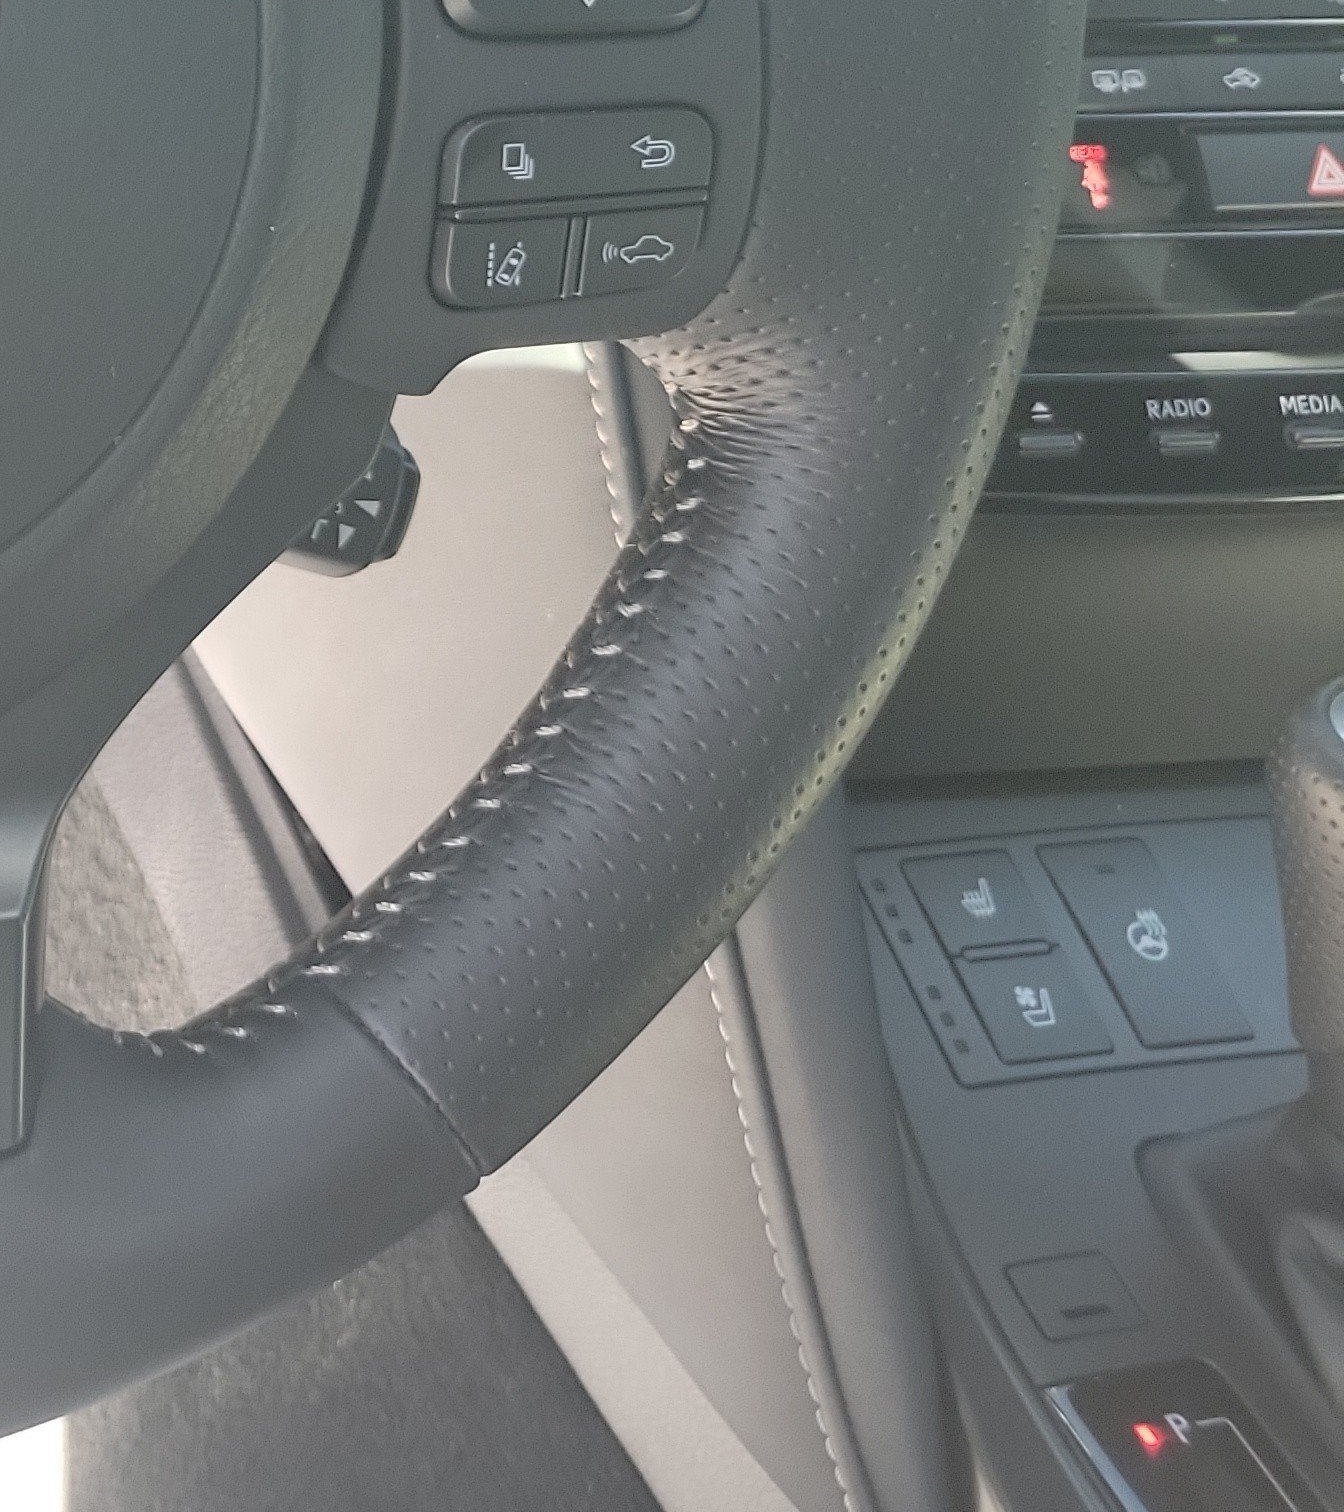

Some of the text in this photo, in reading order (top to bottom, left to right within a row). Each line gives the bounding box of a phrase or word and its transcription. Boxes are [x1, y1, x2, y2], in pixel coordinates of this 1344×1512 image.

[1145, 398, 1212, 421] RADIO
[1279, 394, 1344, 416] MEDIA
[1163, 1412, 1190, 1444] P
